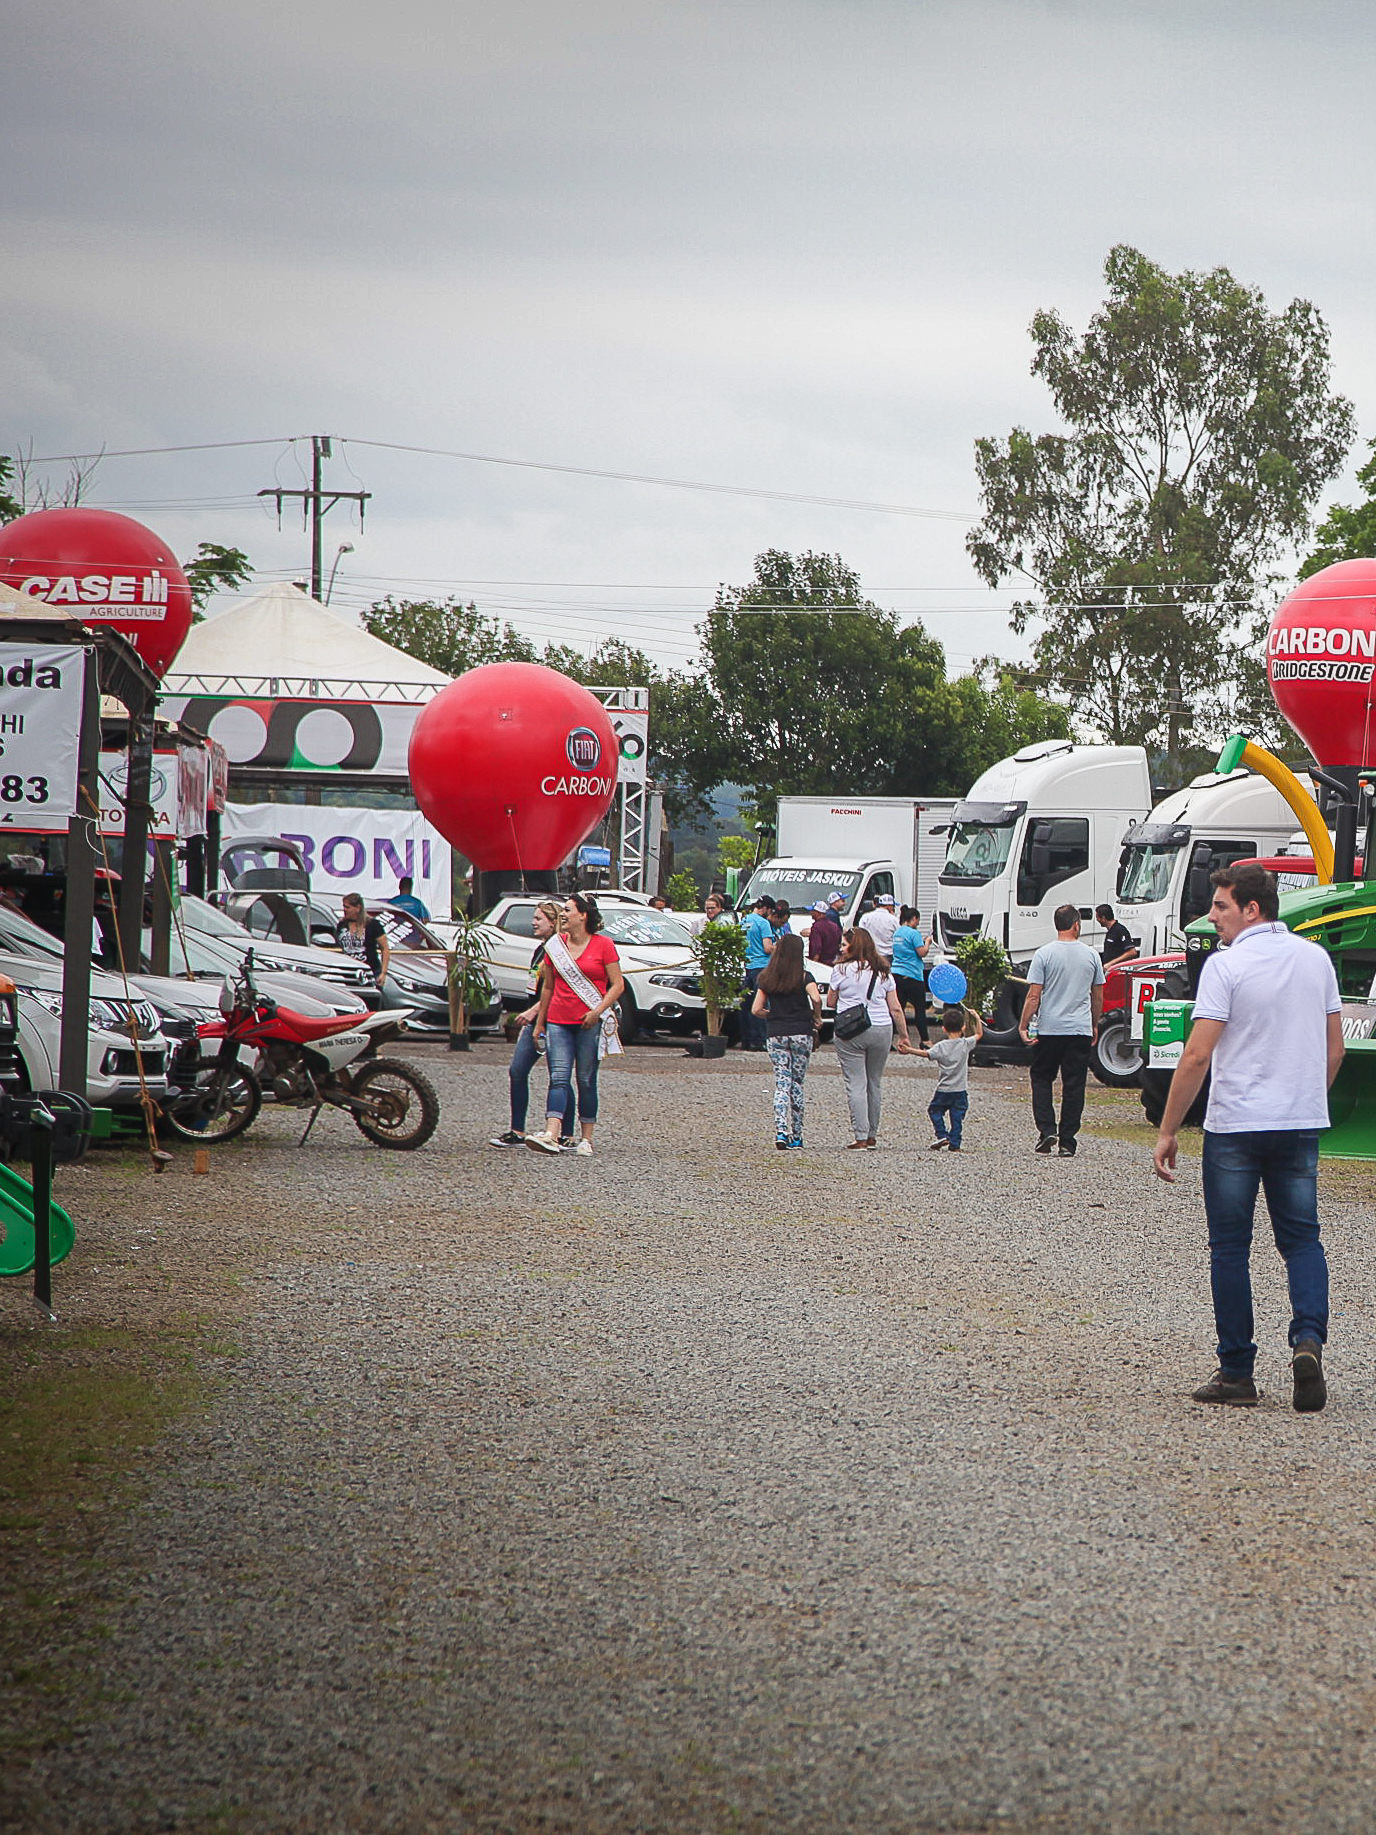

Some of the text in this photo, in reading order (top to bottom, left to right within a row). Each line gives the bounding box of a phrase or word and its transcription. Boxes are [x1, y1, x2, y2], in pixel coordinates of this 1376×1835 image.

[20, 576, 136, 602] CASE
[90, 607, 163, 617] AGRICULTURE
[0, 659, 61, 689] da
[1272, 661, 1372, 681] BRIDGESTONE
[575, 740, 594, 759] FIAT
[0, 775, 49, 804] 83
[541, 777, 611, 797] CARBONI
[760, 870, 806, 882] MÓVEIS
